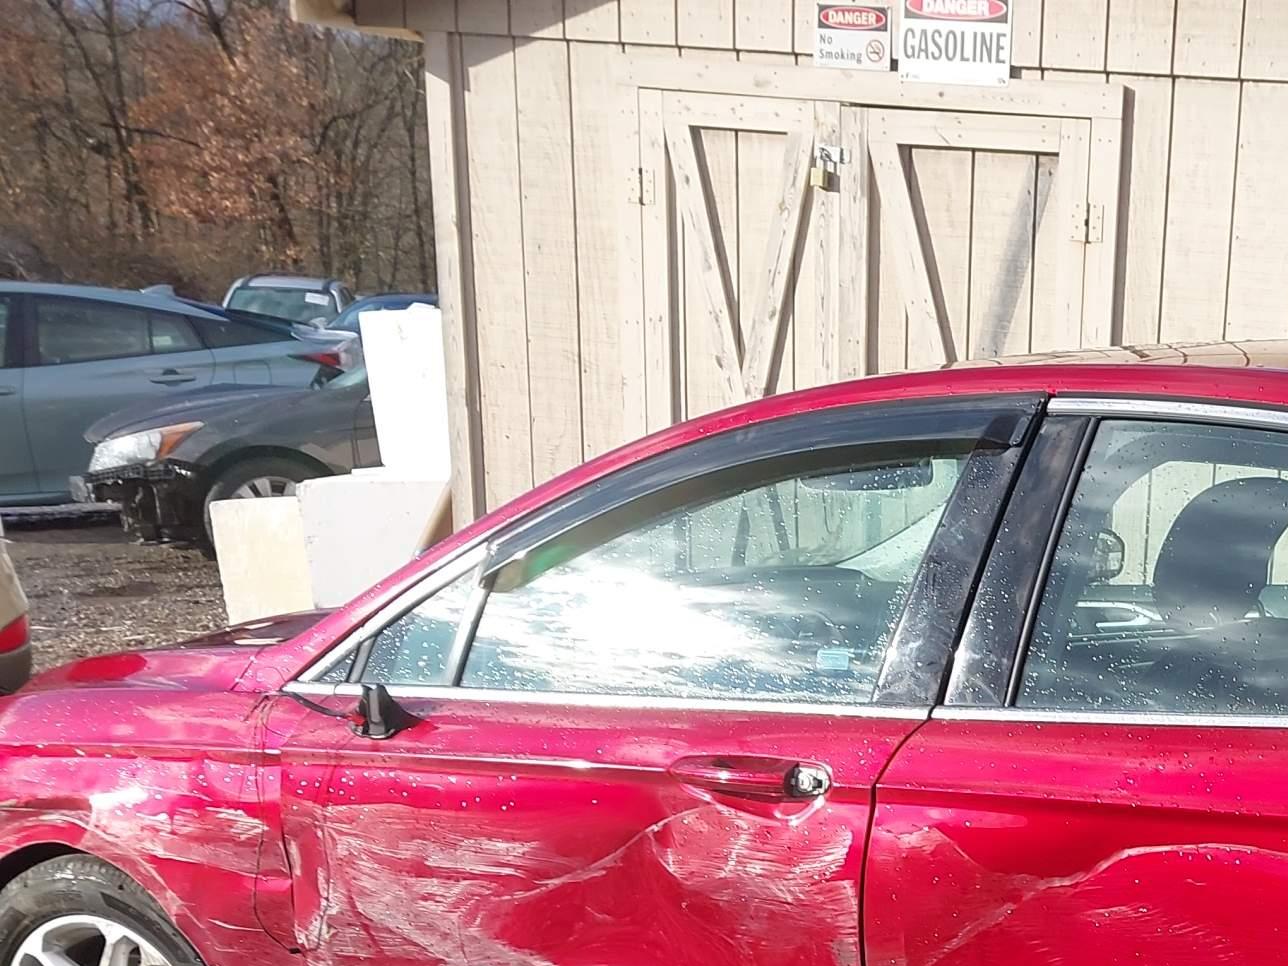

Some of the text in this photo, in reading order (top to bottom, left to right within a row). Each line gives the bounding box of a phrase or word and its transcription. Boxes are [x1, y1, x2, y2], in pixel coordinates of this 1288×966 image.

[922, 0, 990, 16] DANGER
[827, 11, 877, 26] DANGER
[819, 34, 833, 46] No
[903, 27, 1007, 64] GASOLINE
[819, 49, 863, 65] Smoking
